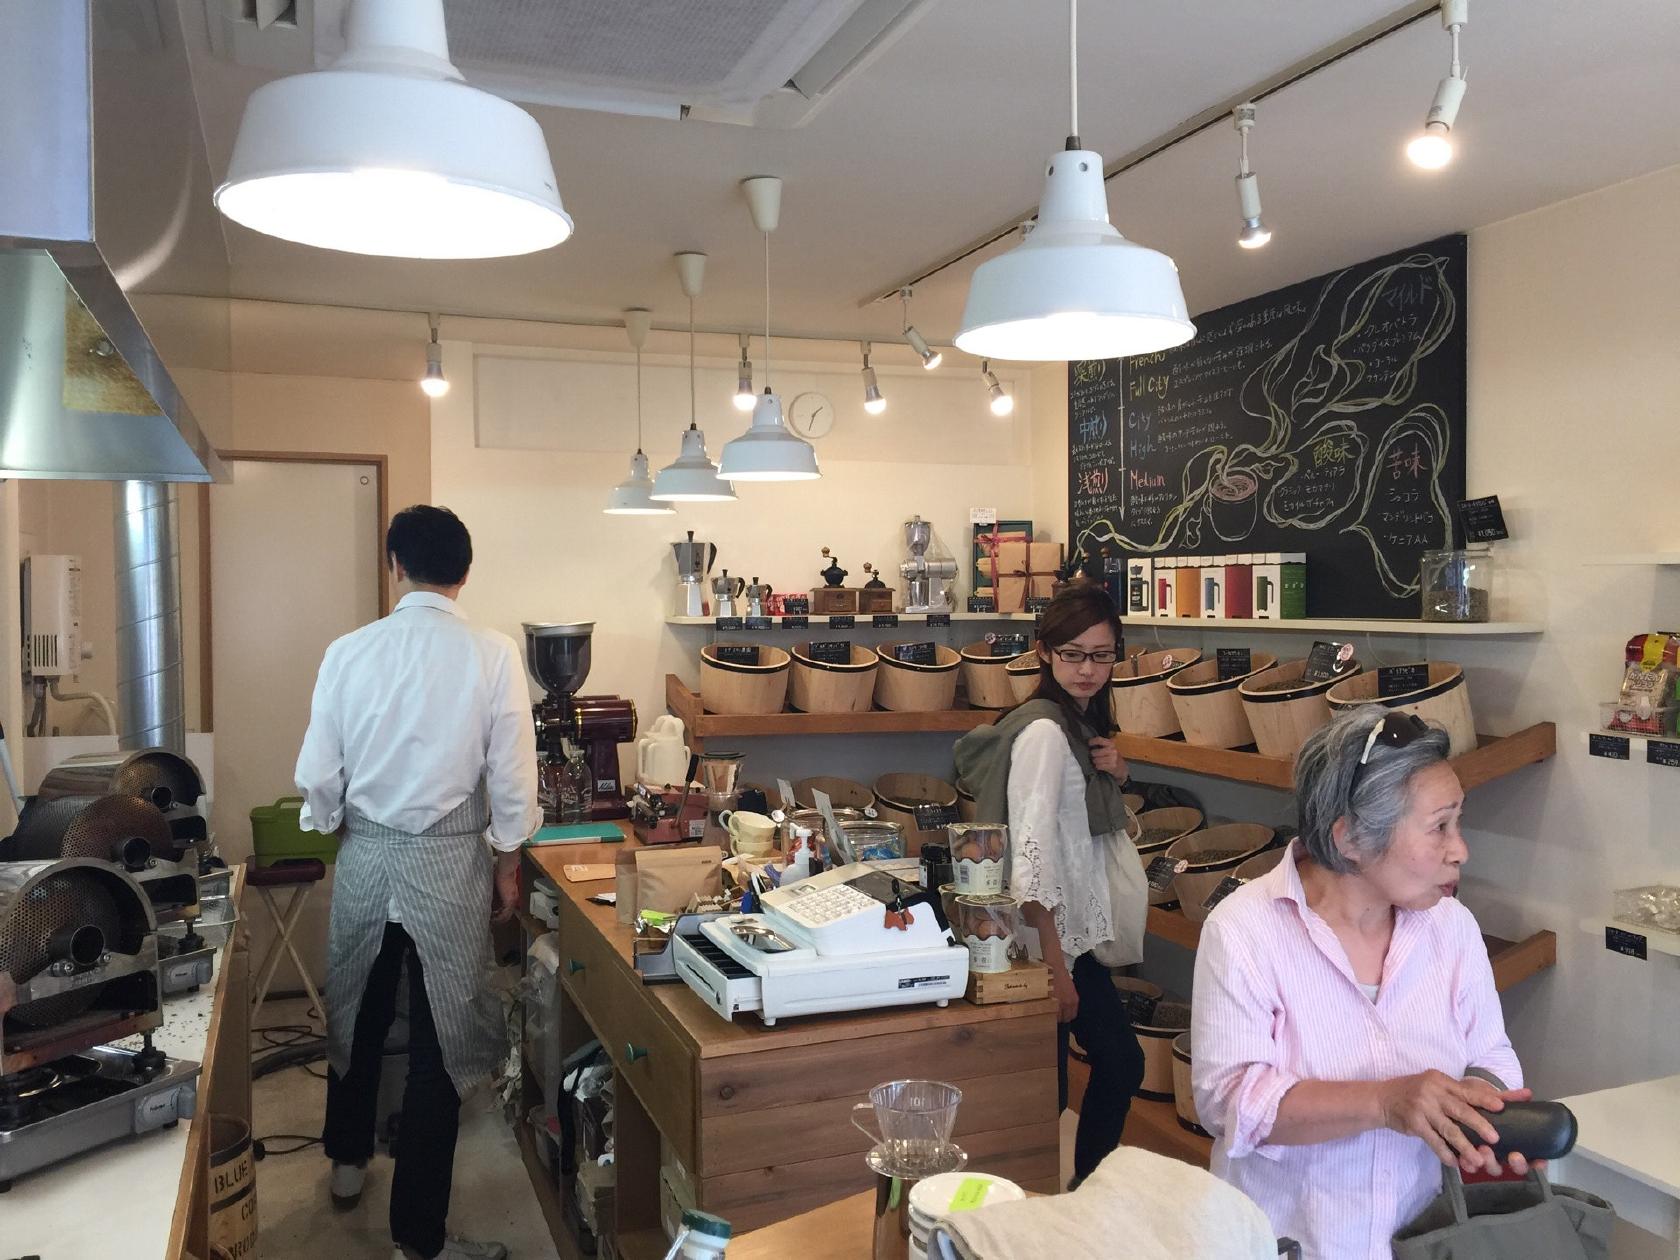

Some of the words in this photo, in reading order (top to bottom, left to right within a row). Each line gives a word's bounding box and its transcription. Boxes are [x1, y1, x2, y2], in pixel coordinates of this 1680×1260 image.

[1129, 377, 1146, 401] Full
[1147, 374, 1170, 399] City
[1128, 411, 1151, 432] City
[1130, 437, 1157, 460] High
[1313, 437, 1356, 468] 酸味
[1386, 442, 1429, 480] 苦味
[1130, 469, 1165, 490] Medium
[214, 1159, 249, 1194] BLUE
